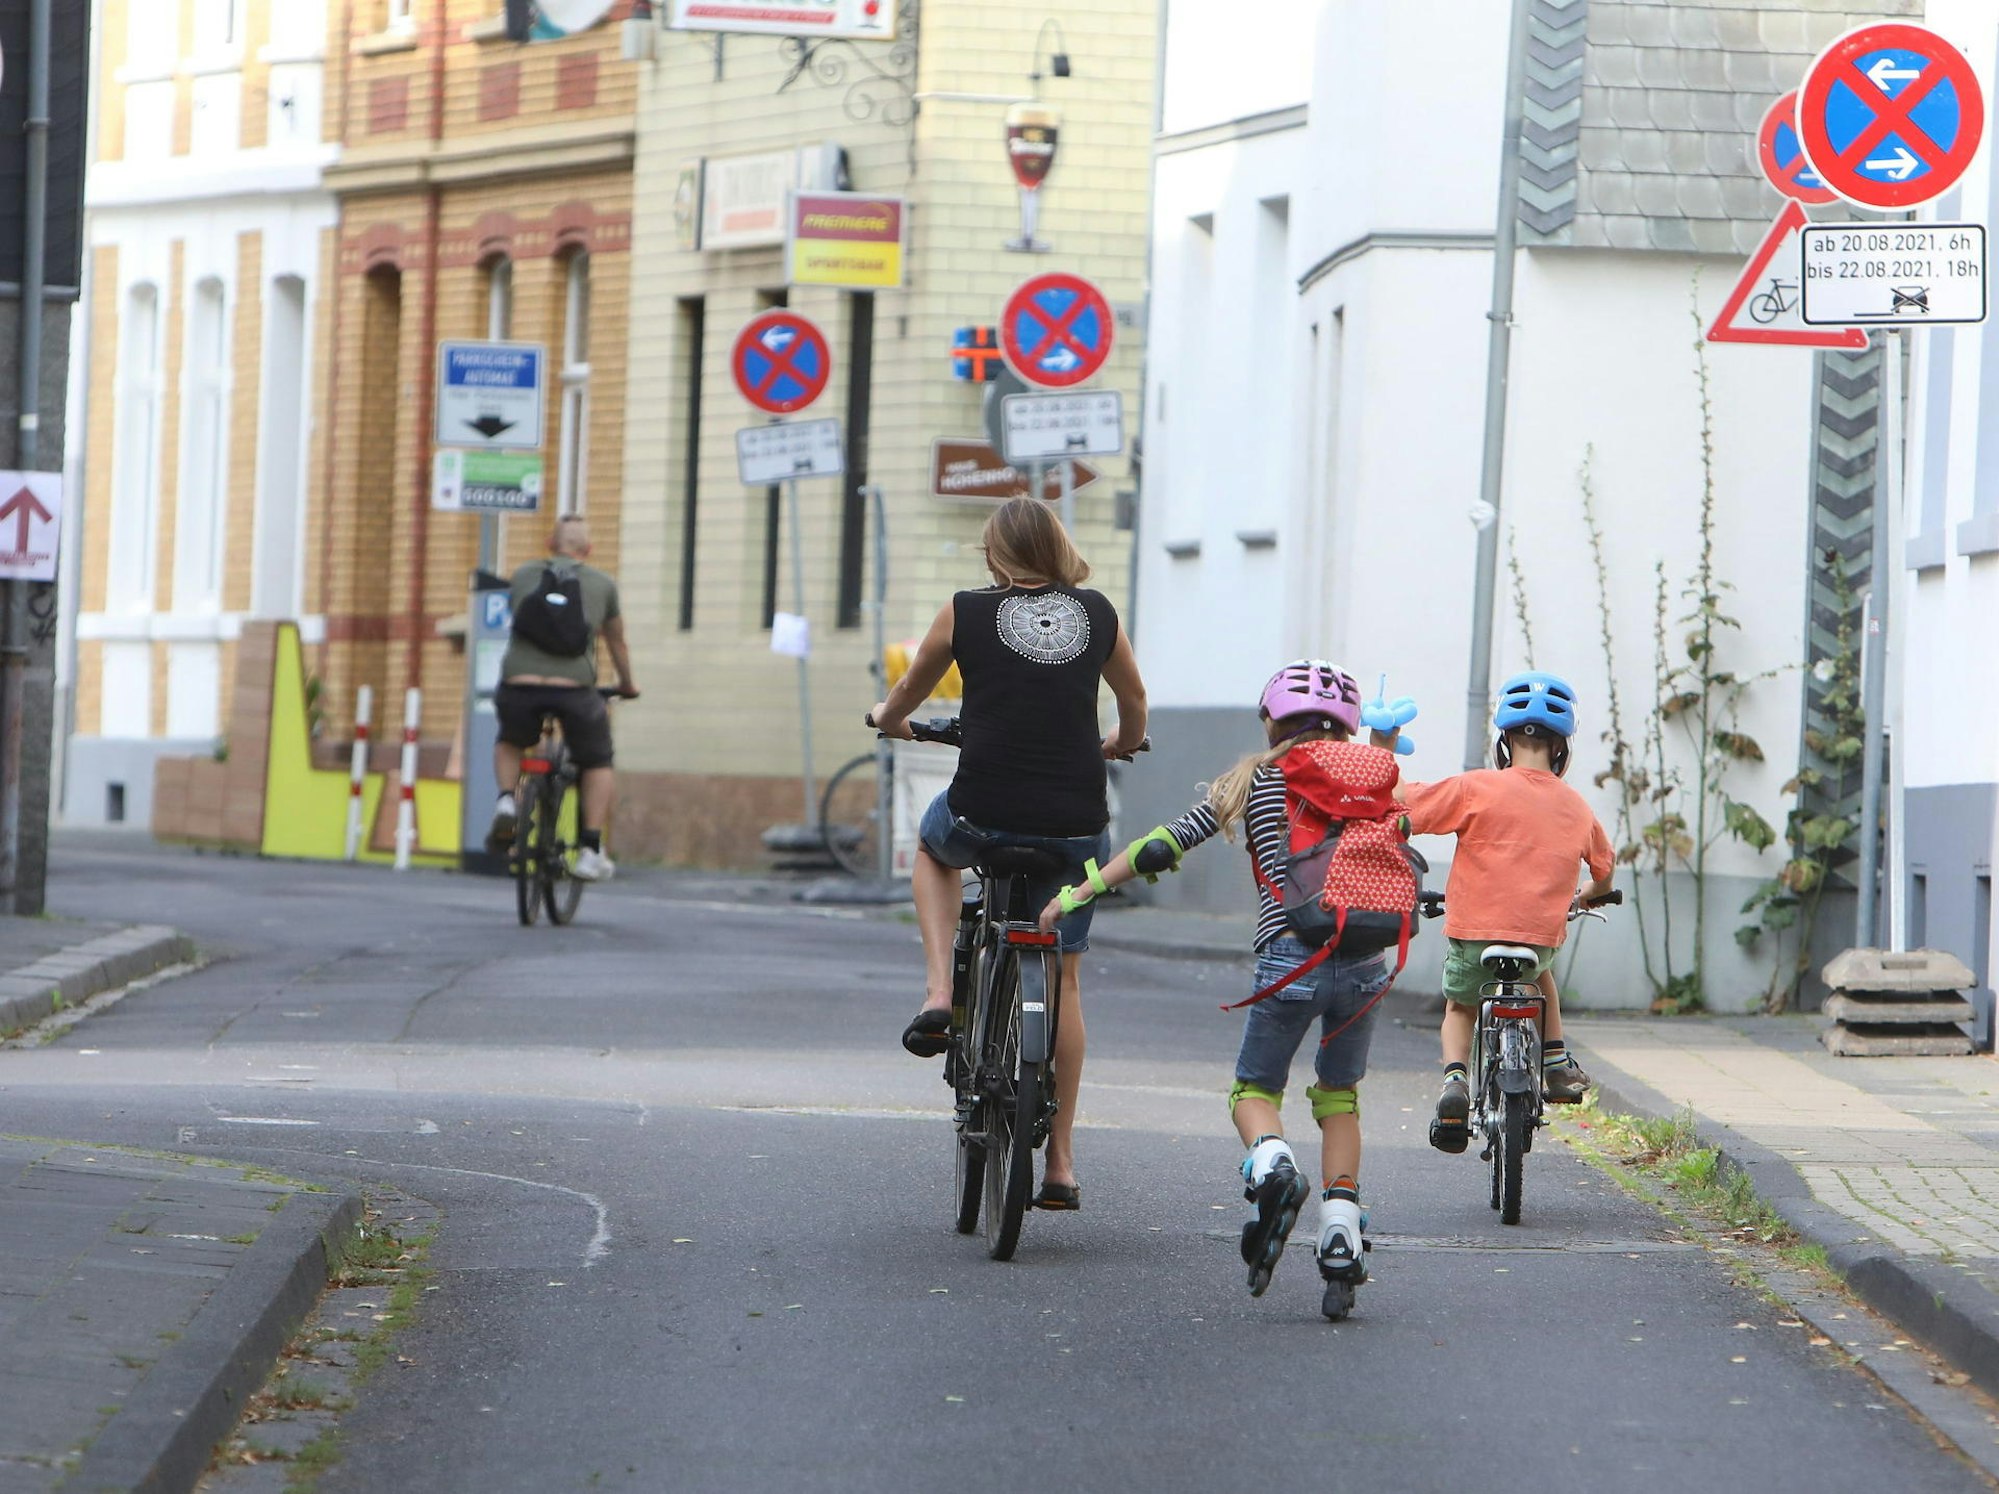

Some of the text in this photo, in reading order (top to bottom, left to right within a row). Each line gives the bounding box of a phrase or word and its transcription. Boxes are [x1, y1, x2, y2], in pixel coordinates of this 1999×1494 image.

[803, 214, 889, 232] PREMIERE
[1814, 235, 1835, 252] ab
[1949, 233, 1971, 250] 6h
[1807, 262, 1833, 278] bis
[1949, 260, 1979, 277] 18h
[1534, 682, 1545, 692] W
